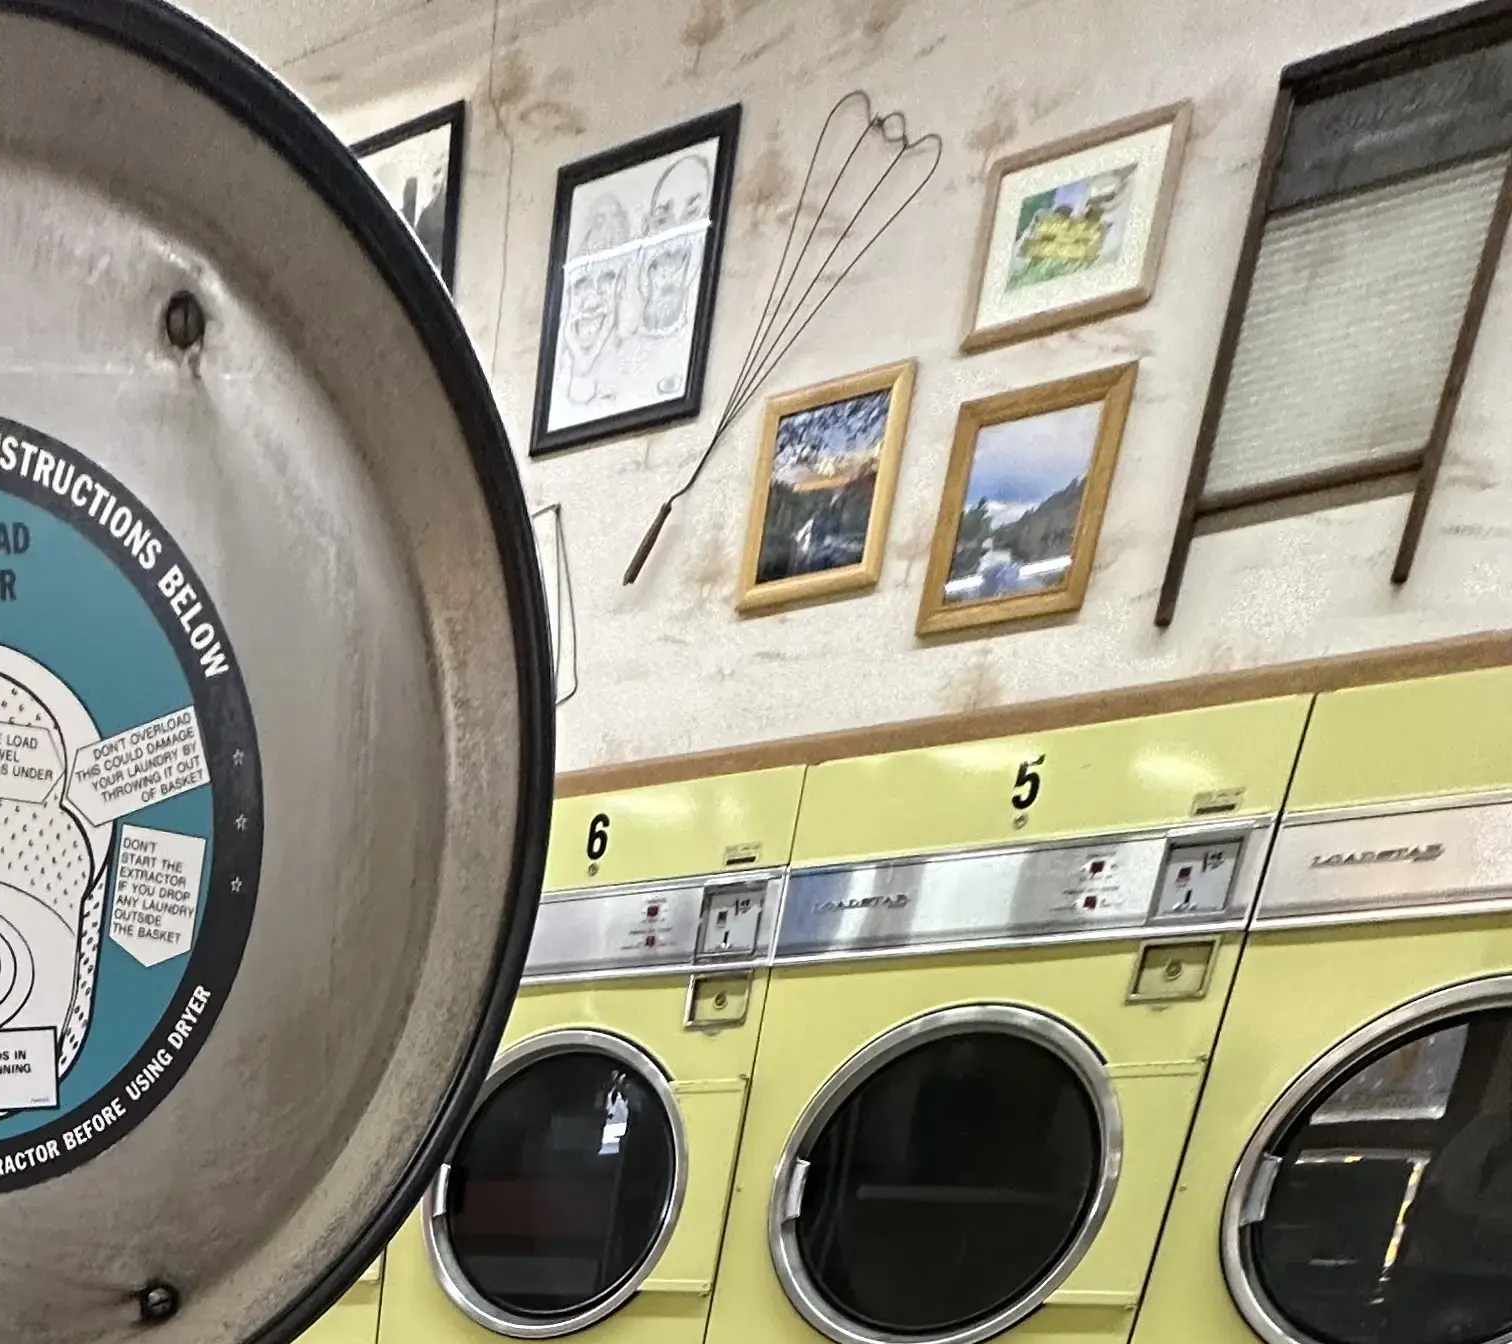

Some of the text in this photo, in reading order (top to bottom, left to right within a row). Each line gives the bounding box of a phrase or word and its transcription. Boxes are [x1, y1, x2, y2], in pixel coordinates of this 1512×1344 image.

[157, 564, 229, 678] BELOW
[6, 733, 38, 749] LOAD
[93, 712, 191, 760] DON'T OVERLOAD
[75, 727, 194, 783] THIS COULD DAMAGE
[92, 740, 196, 791] YOUR LAUNDRY BY
[12, 766, 53, 780] UNDER
[101, 755, 200, 803] THROWING IT OUT
[1012, 754, 1045, 810] 5
[141, 769, 203, 802] OF BASKET
[123, 837, 157, 853] DON'T
[586, 813, 610, 860] 6
[122, 852, 183, 873] START THE
[120, 866, 186, 888] EXTRACTOR
[118, 880, 190, 901] IF YOU DROP
[114, 908, 162, 927] OUTSIDE
[116, 895, 194, 918] ANY LAUNDRY
[113, 922, 181, 944] THE BASKET
[15, 1050, 26, 1060] IN
[62, 1097, 127, 1151] BEFORE
[125, 1048, 173, 1101] USING
[167, 984, 212, 1050] DRYER
